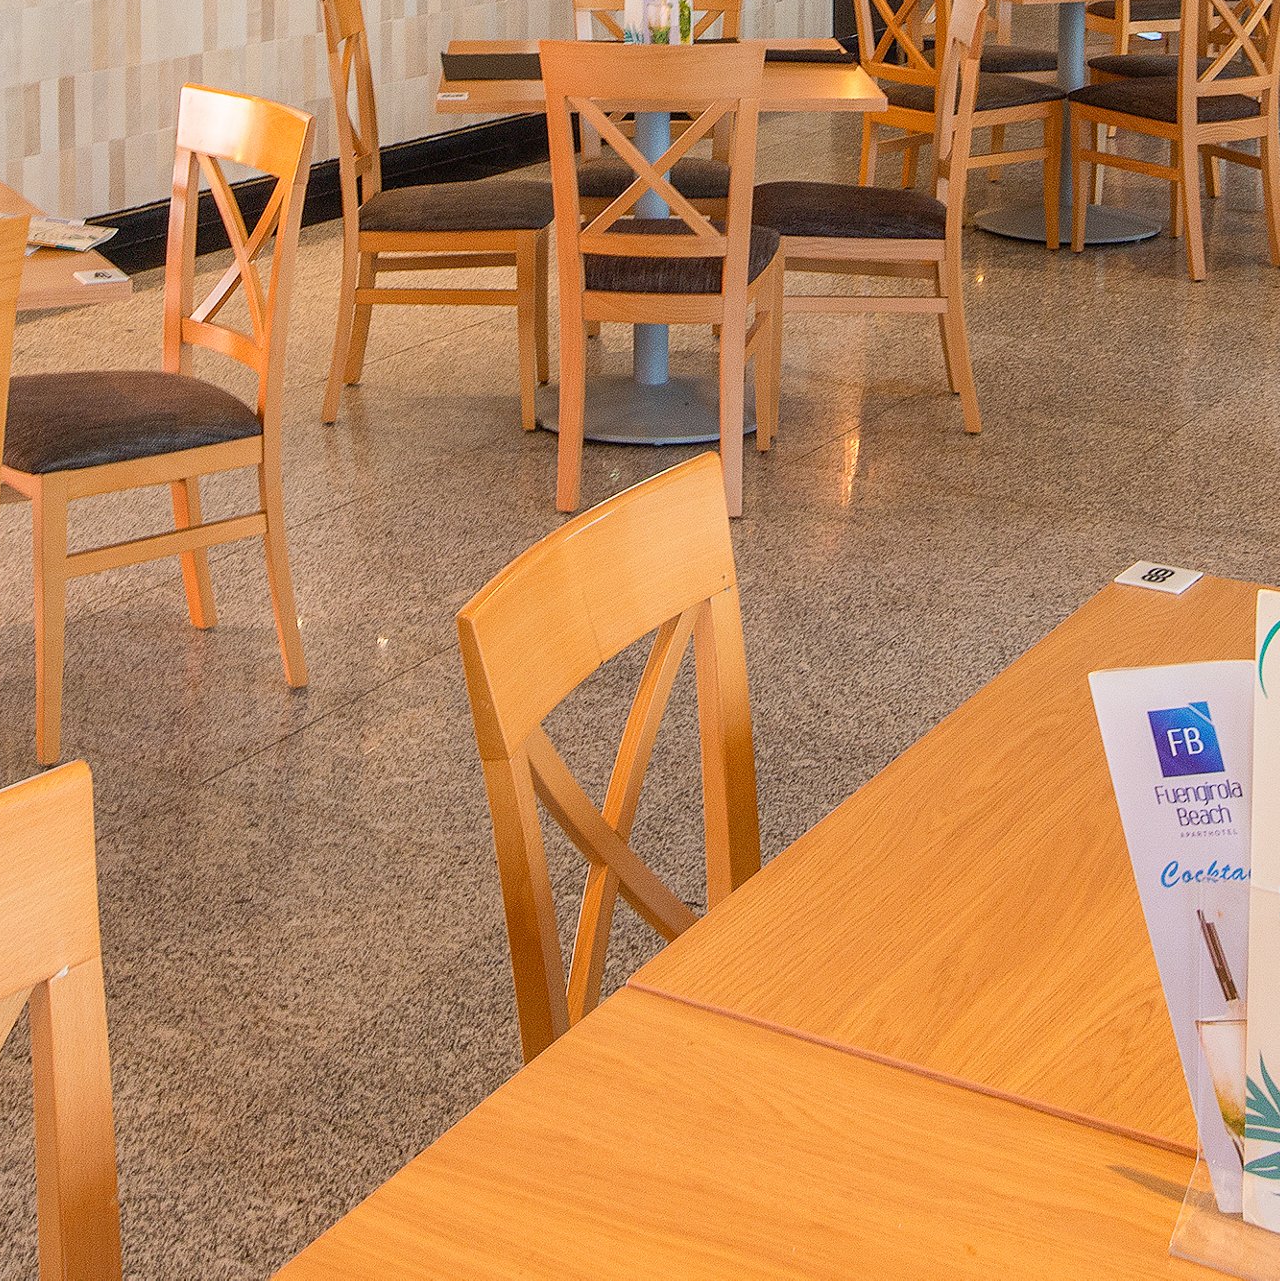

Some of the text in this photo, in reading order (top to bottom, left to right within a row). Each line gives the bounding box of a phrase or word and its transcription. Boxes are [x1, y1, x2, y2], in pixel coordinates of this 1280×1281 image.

[1167, 727, 1205, 757] FB
[1154, 779, 1243, 806] Fuengirola
[1176, 806, 1233, 827] Beach
[1161, 860, 1251, 888] Cockta
